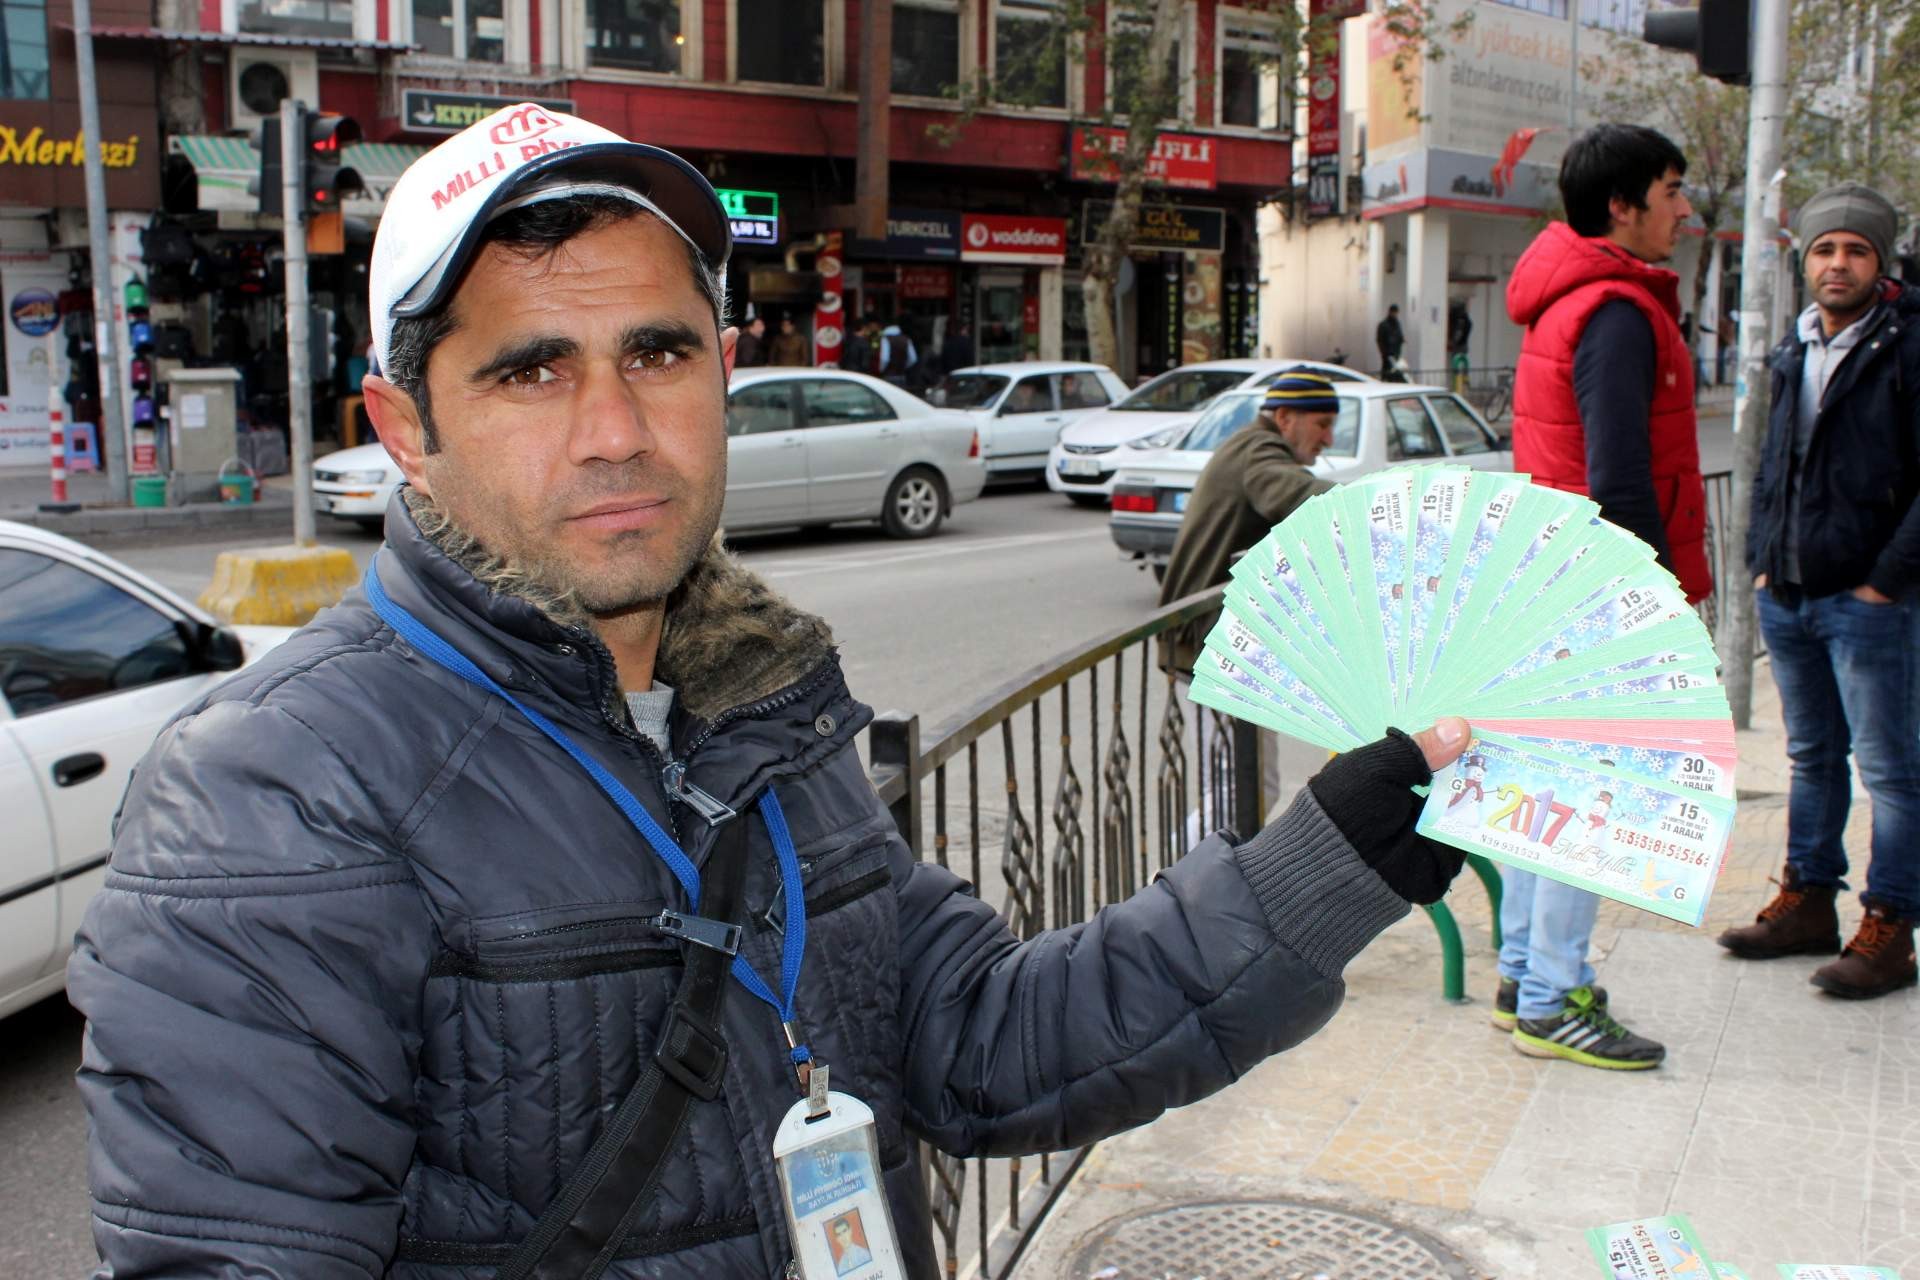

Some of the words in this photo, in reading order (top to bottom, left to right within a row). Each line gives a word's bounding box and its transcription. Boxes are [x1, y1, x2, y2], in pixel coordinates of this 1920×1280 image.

[430, 151, 507, 210] MİLLİ
[991, 227, 1061, 247] vodafone
[1391, 491, 1402, 519] ARALIK
[1422, 494, 1437, 513] 15
[1444, 484, 1455, 514] ARALIK
[1371, 505, 1386, 524] 15
[1485, 501, 1504, 520] 15
[1542, 524, 1560, 541] 15
[1620, 589, 1642, 609] 15
[1622, 621, 1634, 631] 31
[1634, 601, 1663, 624] ARALIK
[1232, 635, 1249, 652] 15
[1220, 656, 1236, 674] 15
[1667, 674, 1689, 691] 15
[1683, 757, 1704, 774] 30
[1451, 779, 1463, 791] G
[1487, 783, 1577, 848] 2017
[1680, 802, 1700, 820] 15
[1660, 821, 1672, 832] 31
[1672, 825, 1704, 842] ARALIK
[1673, 887, 1686, 900] G
[1669, 1229, 1681, 1240] G
[1609, 1250, 1627, 1271] 15
[1623, 1237, 1642, 1266] ARALIK
